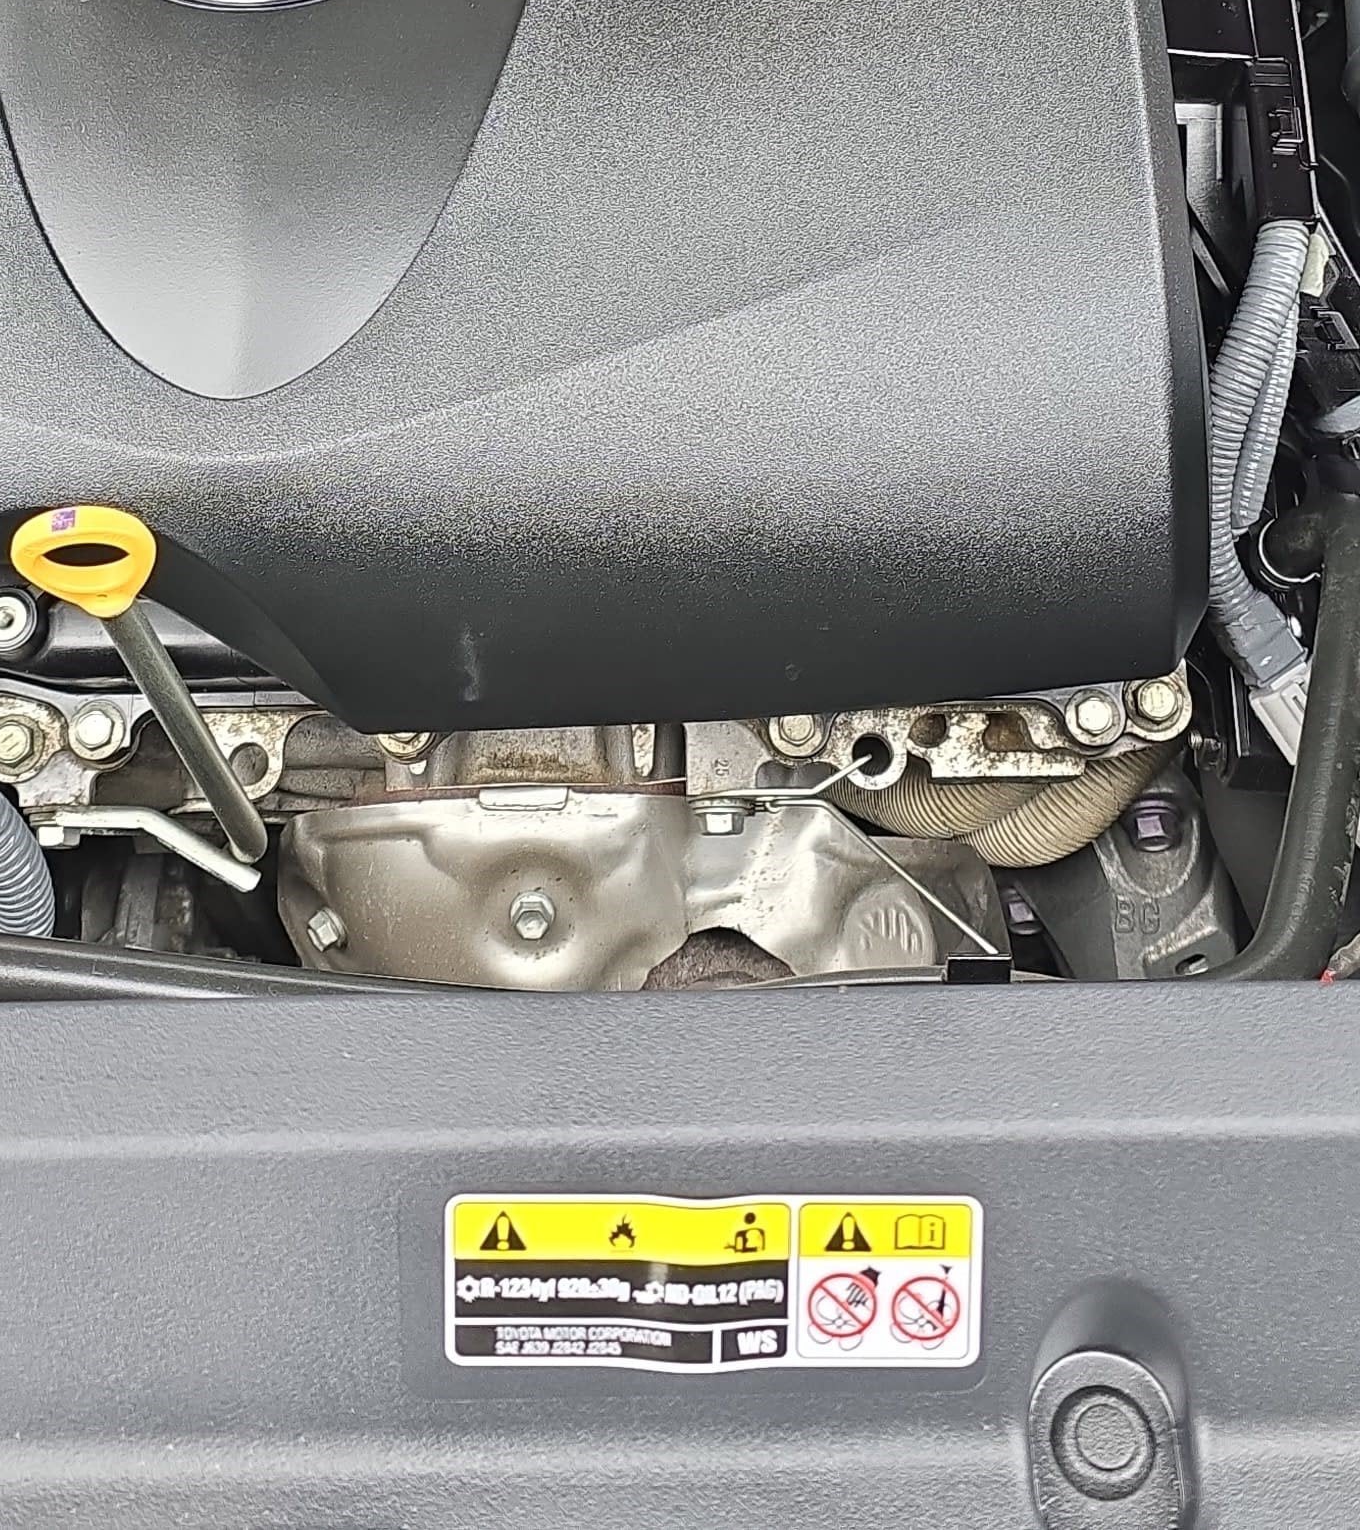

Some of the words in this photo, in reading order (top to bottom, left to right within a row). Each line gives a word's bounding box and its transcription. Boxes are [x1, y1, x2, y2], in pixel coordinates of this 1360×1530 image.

[494, 1326, 543, 1341] TOYOTA
[543, 1326, 587, 1341] MOTOR
[588, 1327, 673, 1347] CORPORATION
